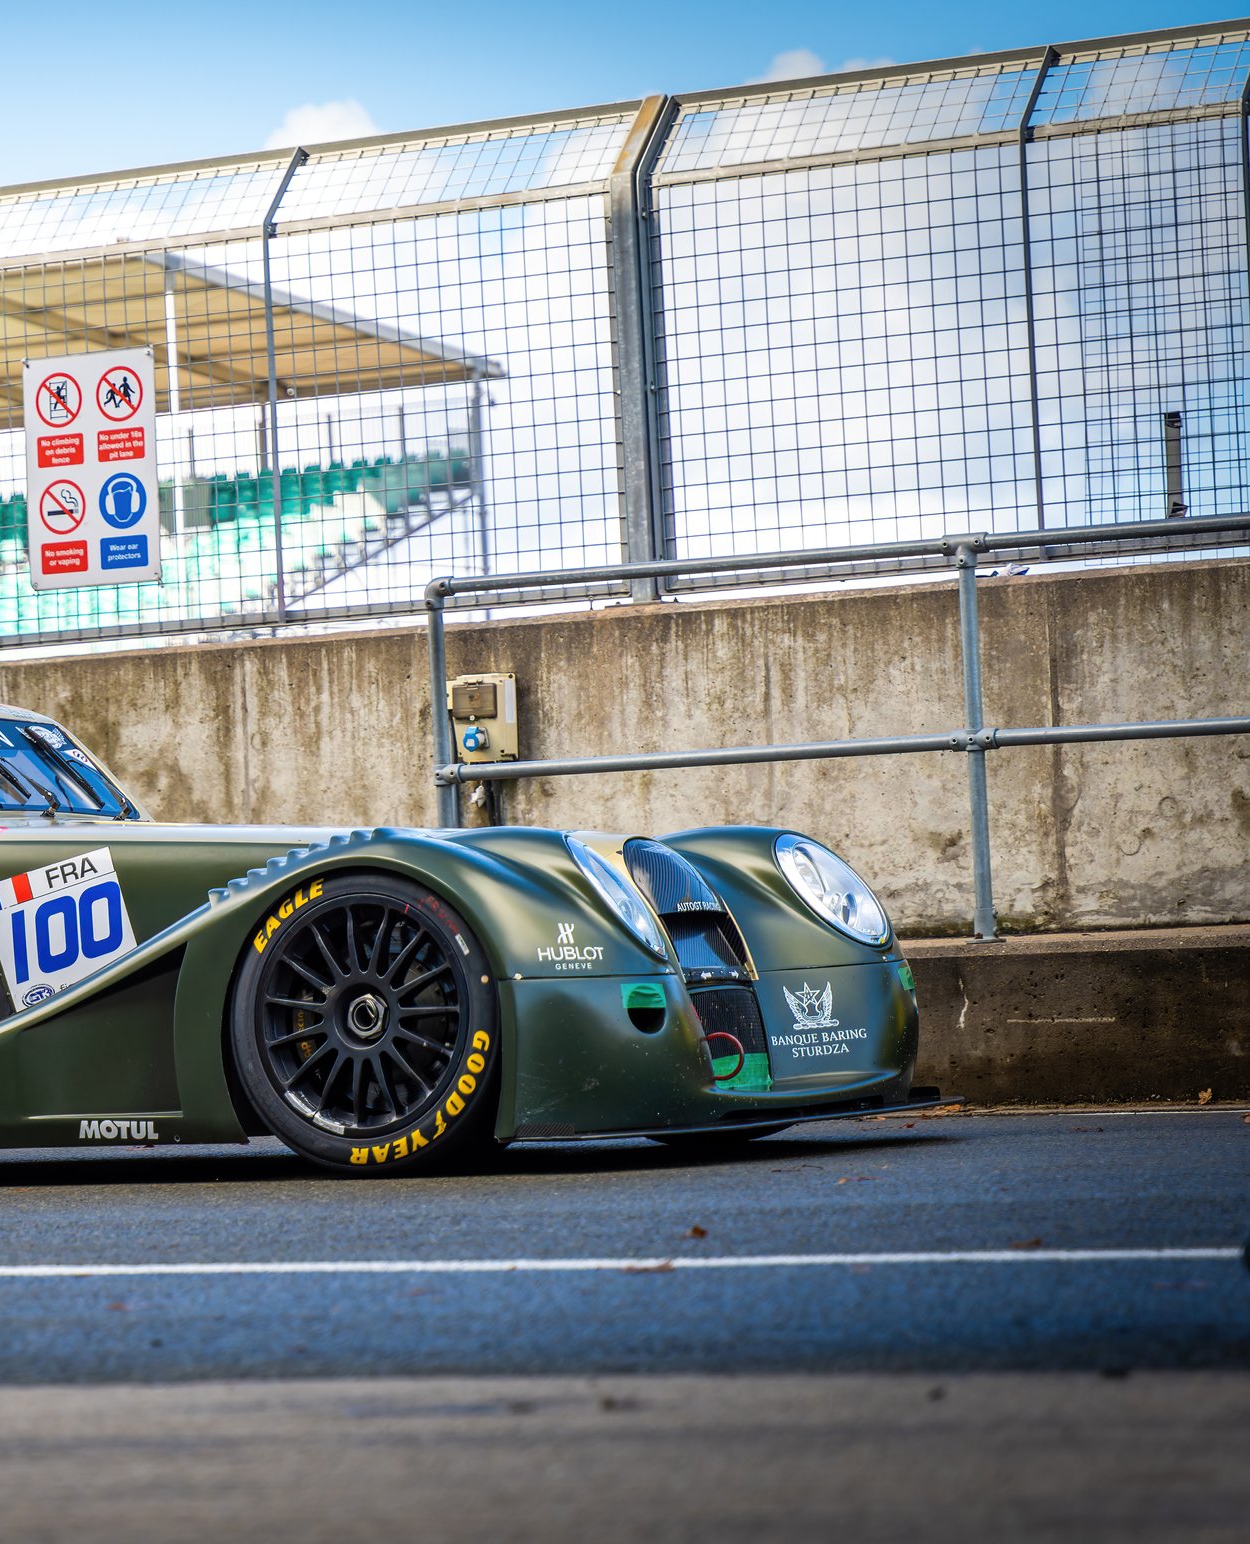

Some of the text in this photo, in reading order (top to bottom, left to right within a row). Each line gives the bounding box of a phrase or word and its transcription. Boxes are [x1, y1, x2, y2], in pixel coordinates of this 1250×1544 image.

[110, 432, 130, 440] under
[51, 437, 80, 446] climbing
[99, 442, 124, 450] allowed
[55, 446, 76, 454] debris
[109, 450, 134, 460] pit lane
[51, 456, 70, 464] fence
[45, 548, 84, 558] No smoking
[109, 544, 127, 552] Wear
[57, 557, 81, 567] vaping
[107, 552, 142, 563] protectors
[45, 856, 99, 889] FRA
[676, 901, 702, 912] AUTOGT
[253, 877, 325, 954] EAGLE
[11, 880, 123, 985] 100
[537, 946, 604, 962] HUBLOT
[555, 962, 593, 970] GENEVE
[771, 1028, 867, 1046] BANQUE BARING
[792, 1042, 850, 1058] STURDZA
[79, 1119, 159, 1140] MOTUL
